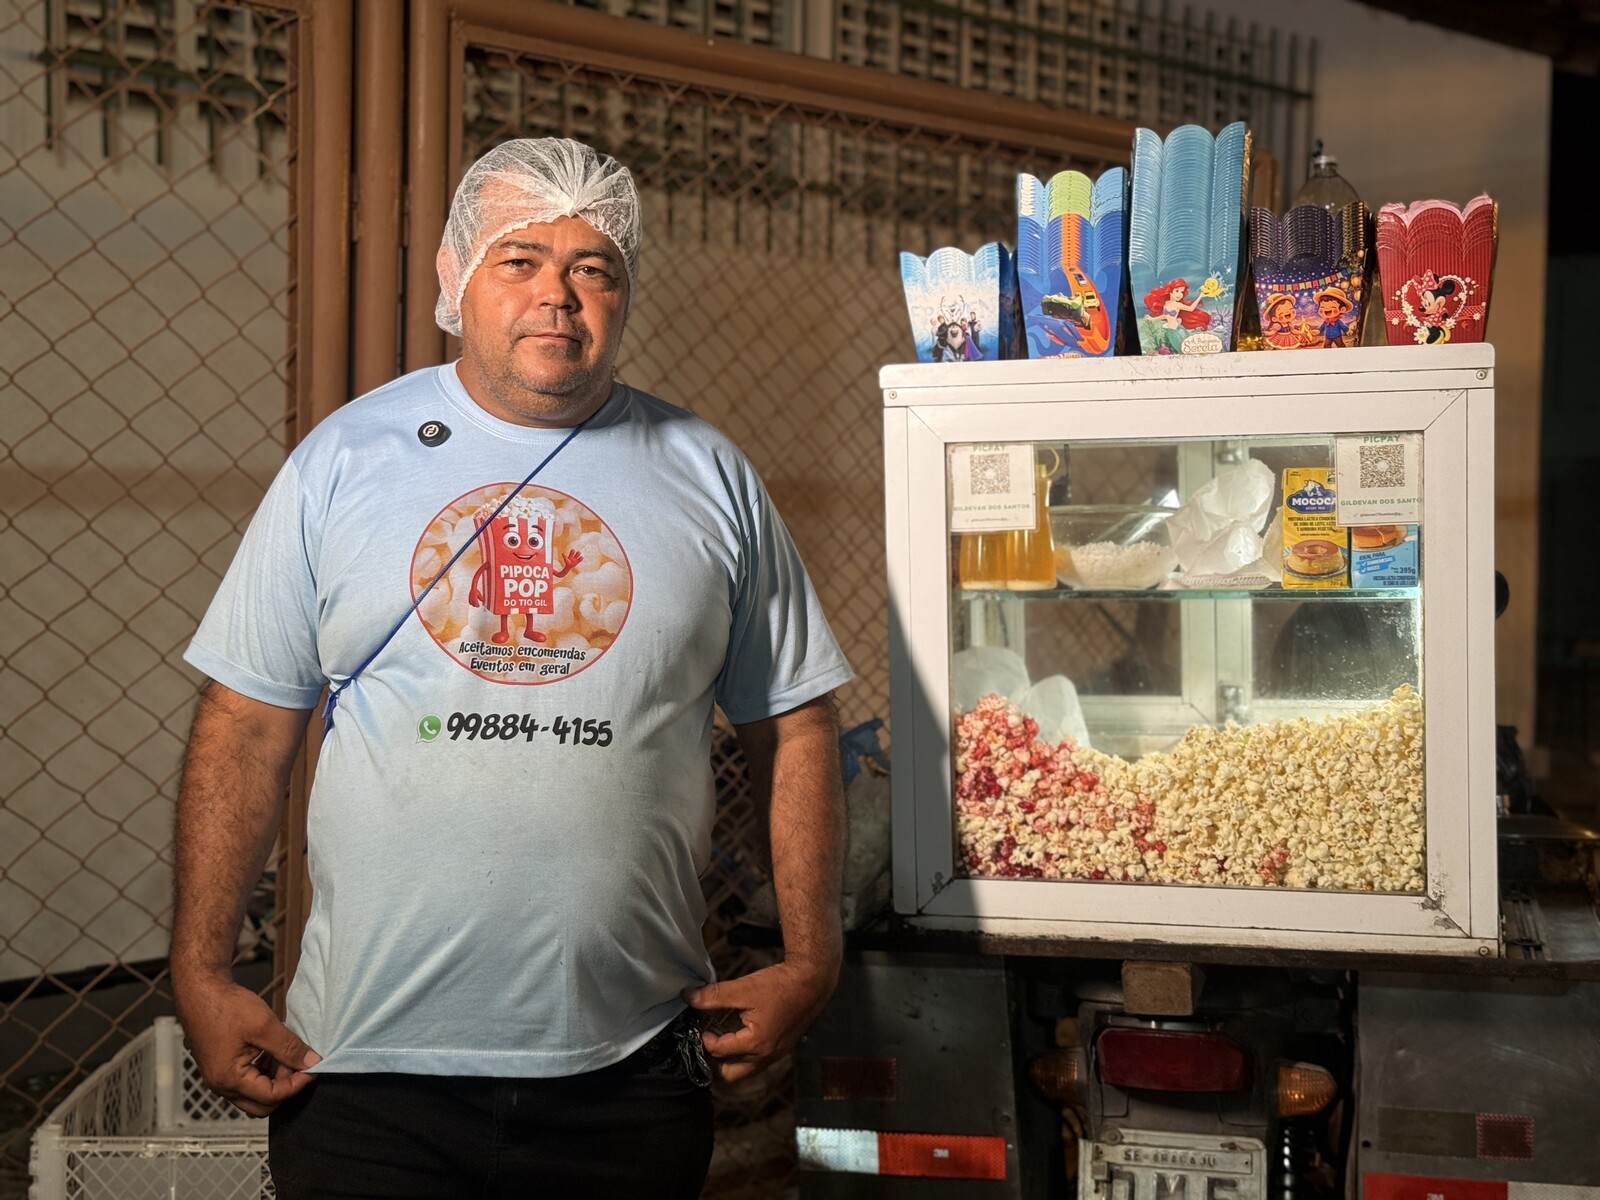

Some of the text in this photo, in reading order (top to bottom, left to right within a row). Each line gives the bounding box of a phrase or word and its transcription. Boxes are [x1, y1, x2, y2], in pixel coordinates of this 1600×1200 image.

[1363, 435, 1400, 443] PICPAY
[500, 564, 550, 579] PIPOCA
[503, 578, 549, 598] POP
[503, 599, 548, 607] DO TIO GIL
[458, 641, 587, 661] Aceitamos encomendas
[470, 657, 571, 676] Eventos em geral
[447, 711, 613, 748] 99884-4155
